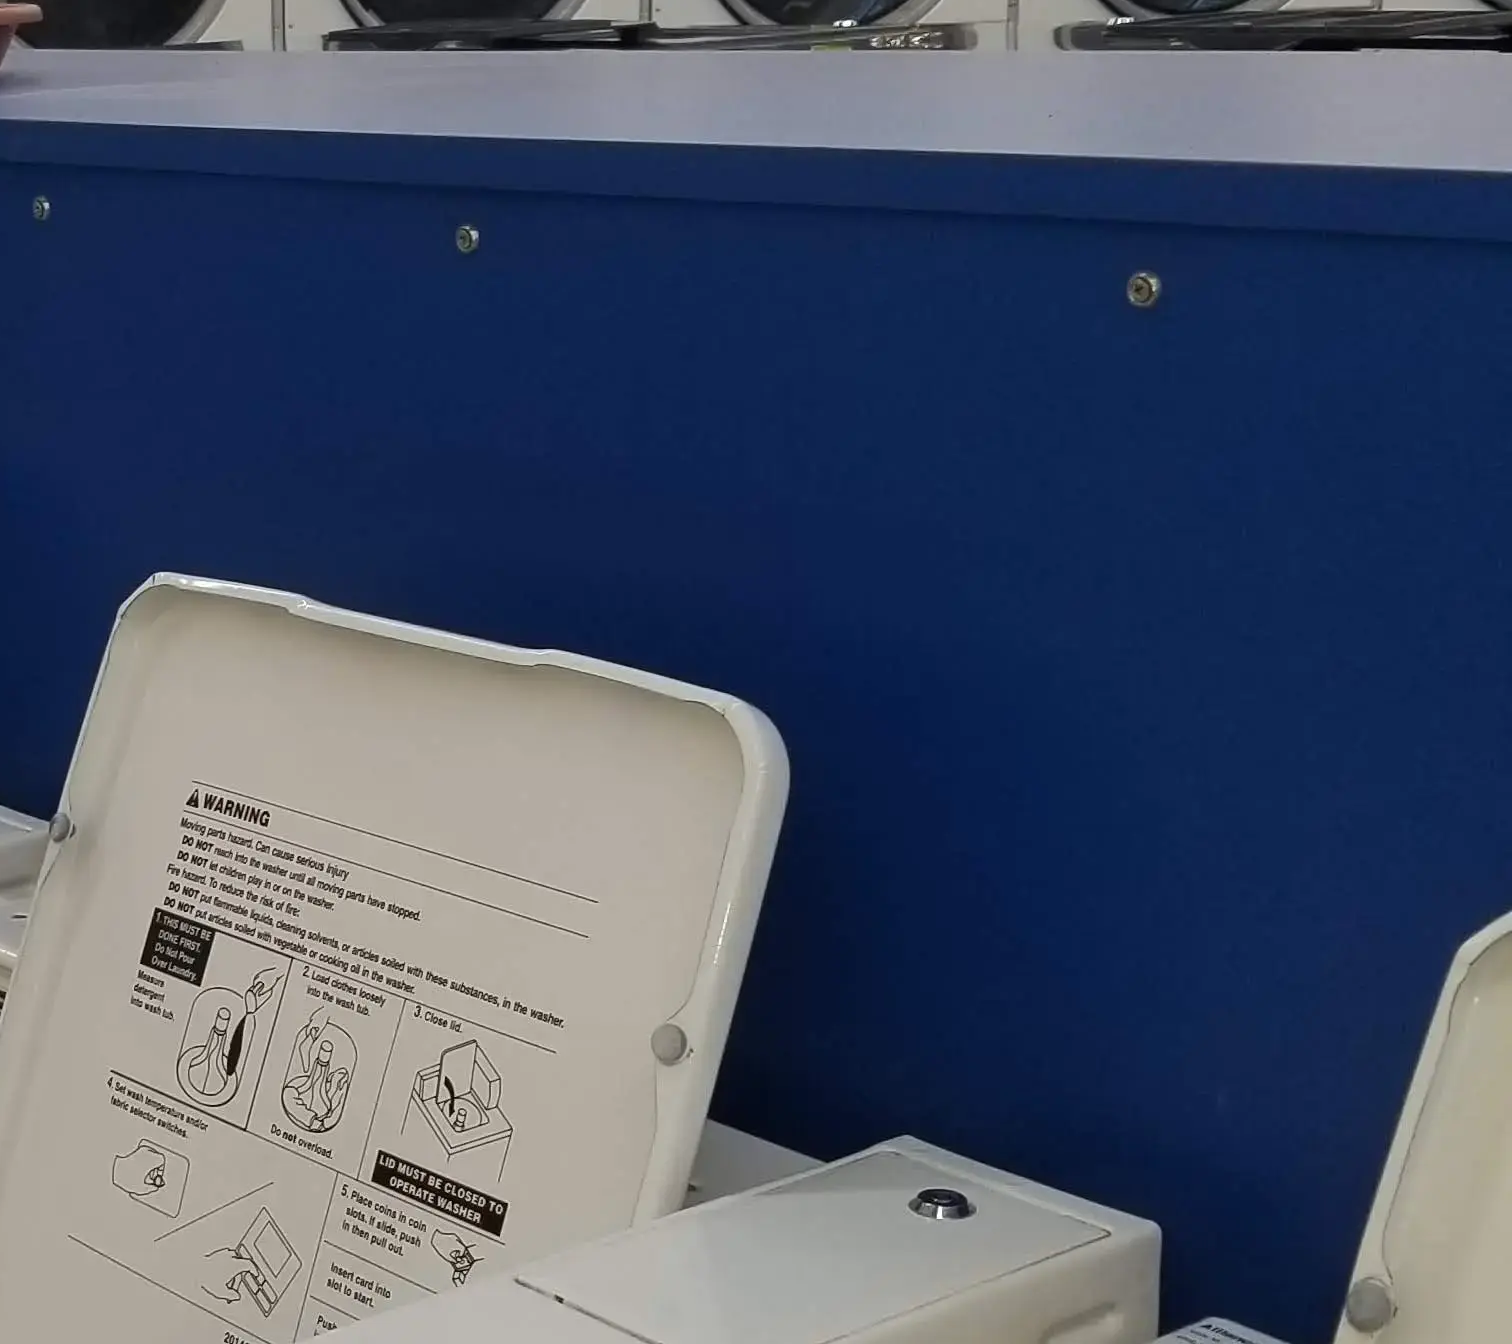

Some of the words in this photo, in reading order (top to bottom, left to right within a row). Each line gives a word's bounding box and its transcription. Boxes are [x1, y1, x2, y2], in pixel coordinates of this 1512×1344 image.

[204, 793, 270, 827] WARNING
[180, 817, 206, 836] Moving
[207, 827, 226, 840] parts
[256, 841, 270, 854] Can
[272, 847, 294, 861] cause
[296, 855, 324, 872] serious
[167, 864, 180, 876] Fire
[209, 877, 217, 888] To
[219, 882, 244, 898] reduce
[246, 891, 258, 902] the
[260, 896, 273, 908] risk
[275, 902, 284, 912] of
[177, 850, 188, 862] DO
[190, 855, 208, 868] NOT
[209, 861, 218, 871] let
[219, 864, 246, 881] children
[248, 875, 264, 888] play
[265, 880, 271, 889] in
[273, 884, 282, 892] or
[282, 886, 291, 895] on
[294, 889, 305, 901] the
[182, 835, 194, 846] DO
[196, 840, 213, 853] NOT
[250, 857, 260, 868] the
[263, 862, 288, 877] washer
[289, 871, 305, 883] until
[306, 876, 316, 886] all
[317, 880, 344, 898] moving
[345, 890, 365, 903] parts
[367, 895, 385, 910] have
[164, 916, 179, 929] THIS
[180, 923, 200, 936] MUST
[200, 930, 212, 941] BE
[164, 897, 175, 908] DO
[177, 901, 195, 914] NOT
[195, 909, 208, 919] put
[208, 914, 232, 928] articles
[234, 923, 256, 937] soiled
[274, 937, 307, 955] vegetable
[309, 949, 318, 958] or
[319, 953, 348, 972] cooking
[350, 964, 360, 974] oil
[362, 968, 370, 977] in
[372, 971, 383, 983] the
[168, 881, 180, 892] DO
[182, 886, 200, 899] NOT
[200, 894, 212, 904] put
[276, 921, 306, 939] cleaning
[342, 944, 350, 953] or
[352, 947, 379, 962] articles
[381, 958, 405, 971] soiled
[407, 966, 423, 978] with
[426, 971, 448, 987] these
[450, 980, 499, 1006] substances,
[502, 997, 511, 1009] in
[513, 1001, 527, 1015] the
[312, 971, 330, 984] Load
[331, 979, 357, 995] clothes
[359, 989, 387, 1007] loosely
[323, 991, 334, 1002] the
[336, 997, 355, 1010] wash
[425, 1011, 448, 1027] Close
[450, 1020, 463, 1033] lid.
[110, 1095, 130, 1110] fabric
[130, 1103, 156, 1123] selector
[115, 1082, 127, 1094] Set
[127, 1086, 144, 1102] wash
[145, 1095, 184, 1121] temperature
[270, 1124, 282, 1135] Do
[282, 1130, 297, 1143] not
[298, 1137, 333, 1159] overload.
[379, 1155, 395, 1169] LID
[398, 1163, 427, 1182] MUST
[428, 1175, 443, 1190] BE
[444, 1183, 487, 1207] CLOSED
[489, 1201, 504, 1214] TO
[389, 1177, 435, 1203] OPERATE
[438, 1197, 482, 1224] WASHER
[341, 1184, 349, 1199] 5.
[351, 1190, 373, 1208] Place
[375, 1201, 397, 1219] coins
[399, 1211, 407, 1223] in
[408, 1216, 427, 1232] coin
[342, 1221, 350, 1231] in
[351, 1224, 370, 1240] then
[371, 1233, 387, 1248] pull
[369, 1216, 376, 1226] If
[399, 1231, 421, 1248] push
[326, 1277, 343, 1294] slot
[344, 1284, 352, 1296] to
[330, 1262, 354, 1282] Insert
[355, 1272, 375, 1290] card
